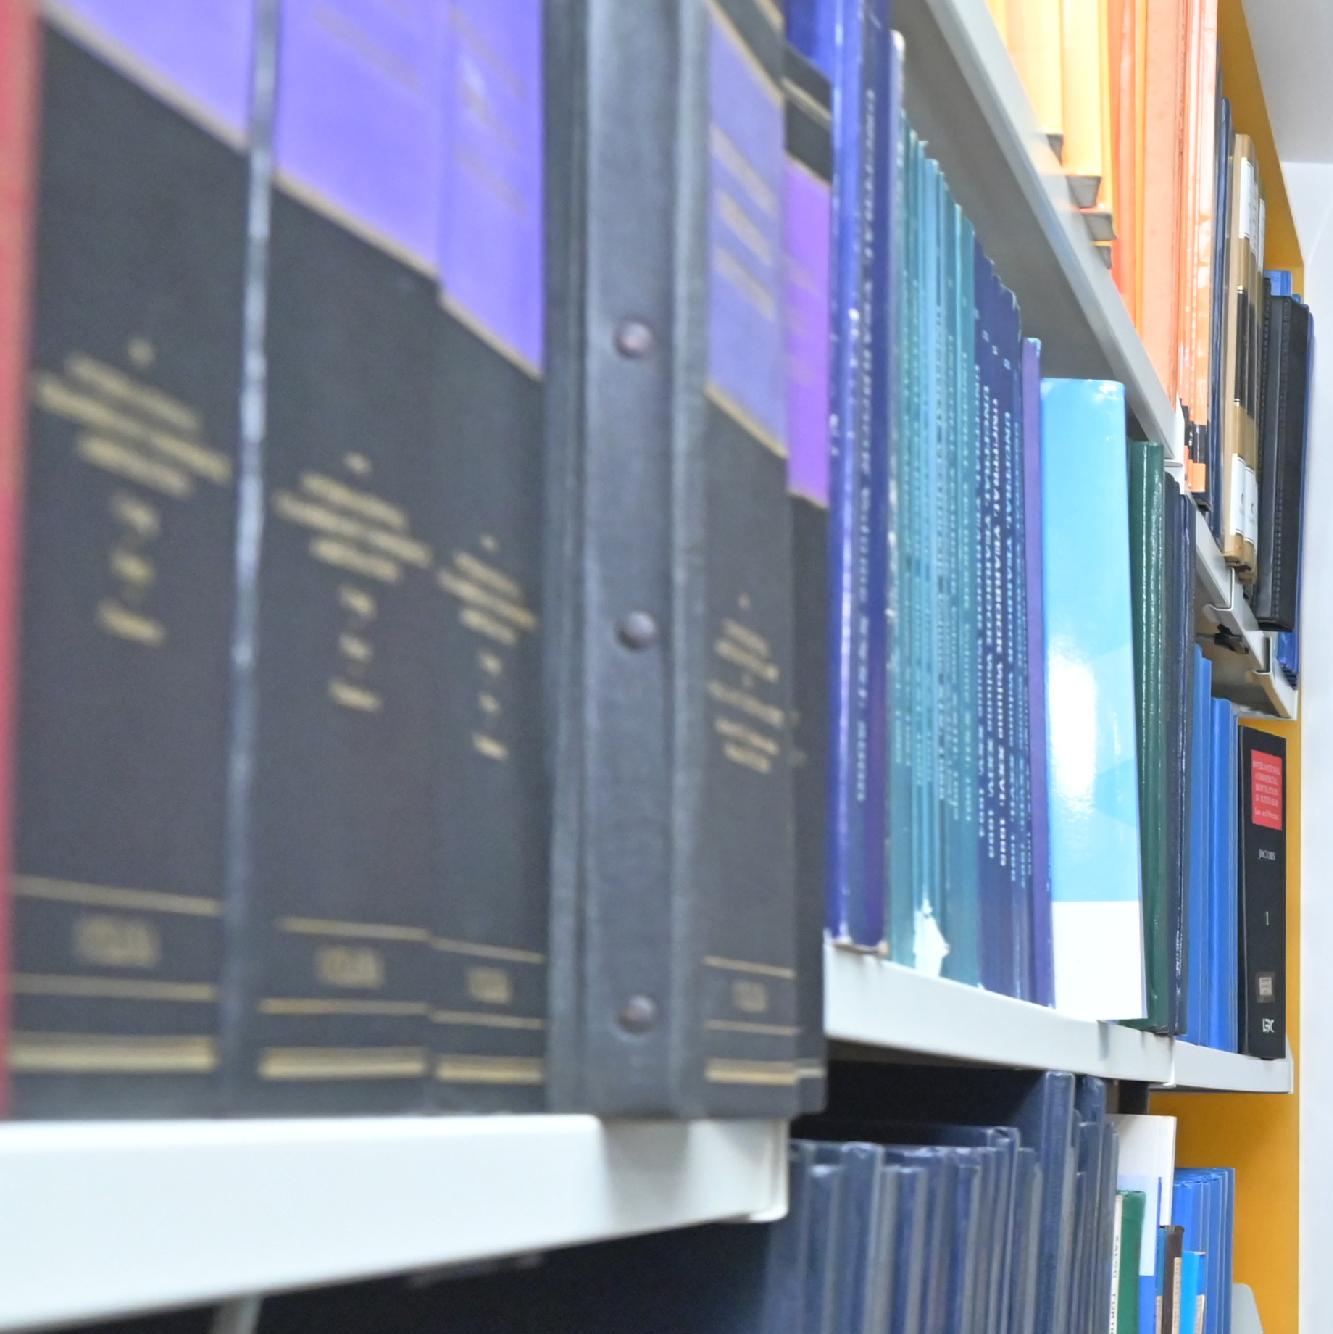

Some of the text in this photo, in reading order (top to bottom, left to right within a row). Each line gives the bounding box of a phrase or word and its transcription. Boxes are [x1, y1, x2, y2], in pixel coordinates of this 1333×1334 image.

[983, 385, 992, 506] UNCITRAL
[992, 398, 1000, 517] UNCITRAL
[1004, 411, 1012, 529] UNCITRAL
[985, 515, 993, 645] YEARBOOK
[994, 525, 1002, 653] YEARBOOK
